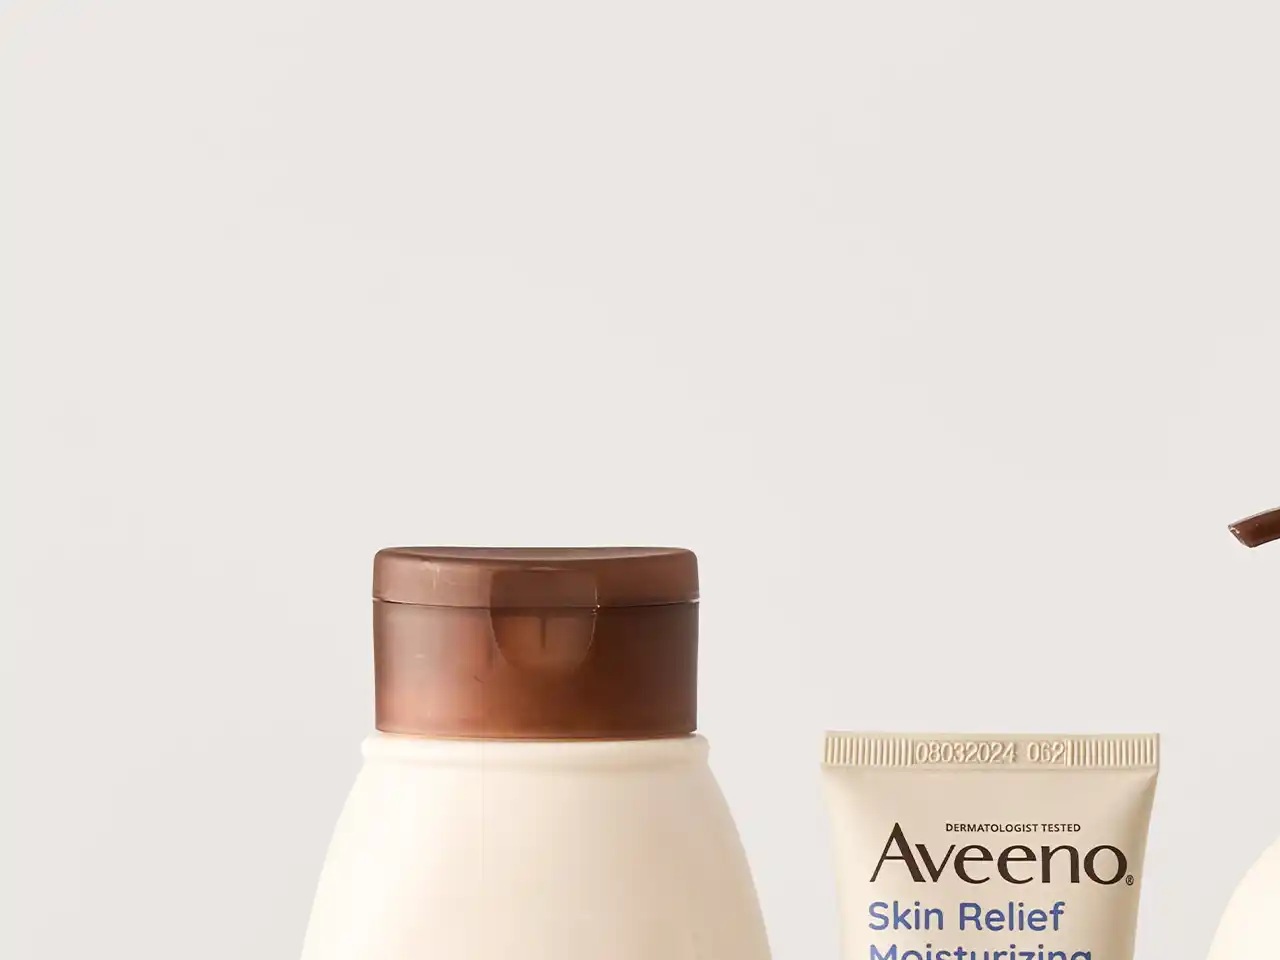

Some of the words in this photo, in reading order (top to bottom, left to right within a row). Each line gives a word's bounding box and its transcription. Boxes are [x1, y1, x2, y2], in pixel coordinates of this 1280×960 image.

[945, 823, 1038, 832] DERMATOLOGIST
[1041, 824, 1081, 832] TESTED
[868, 901, 944, 931] Skin
[959, 901, 1066, 932] Relief
